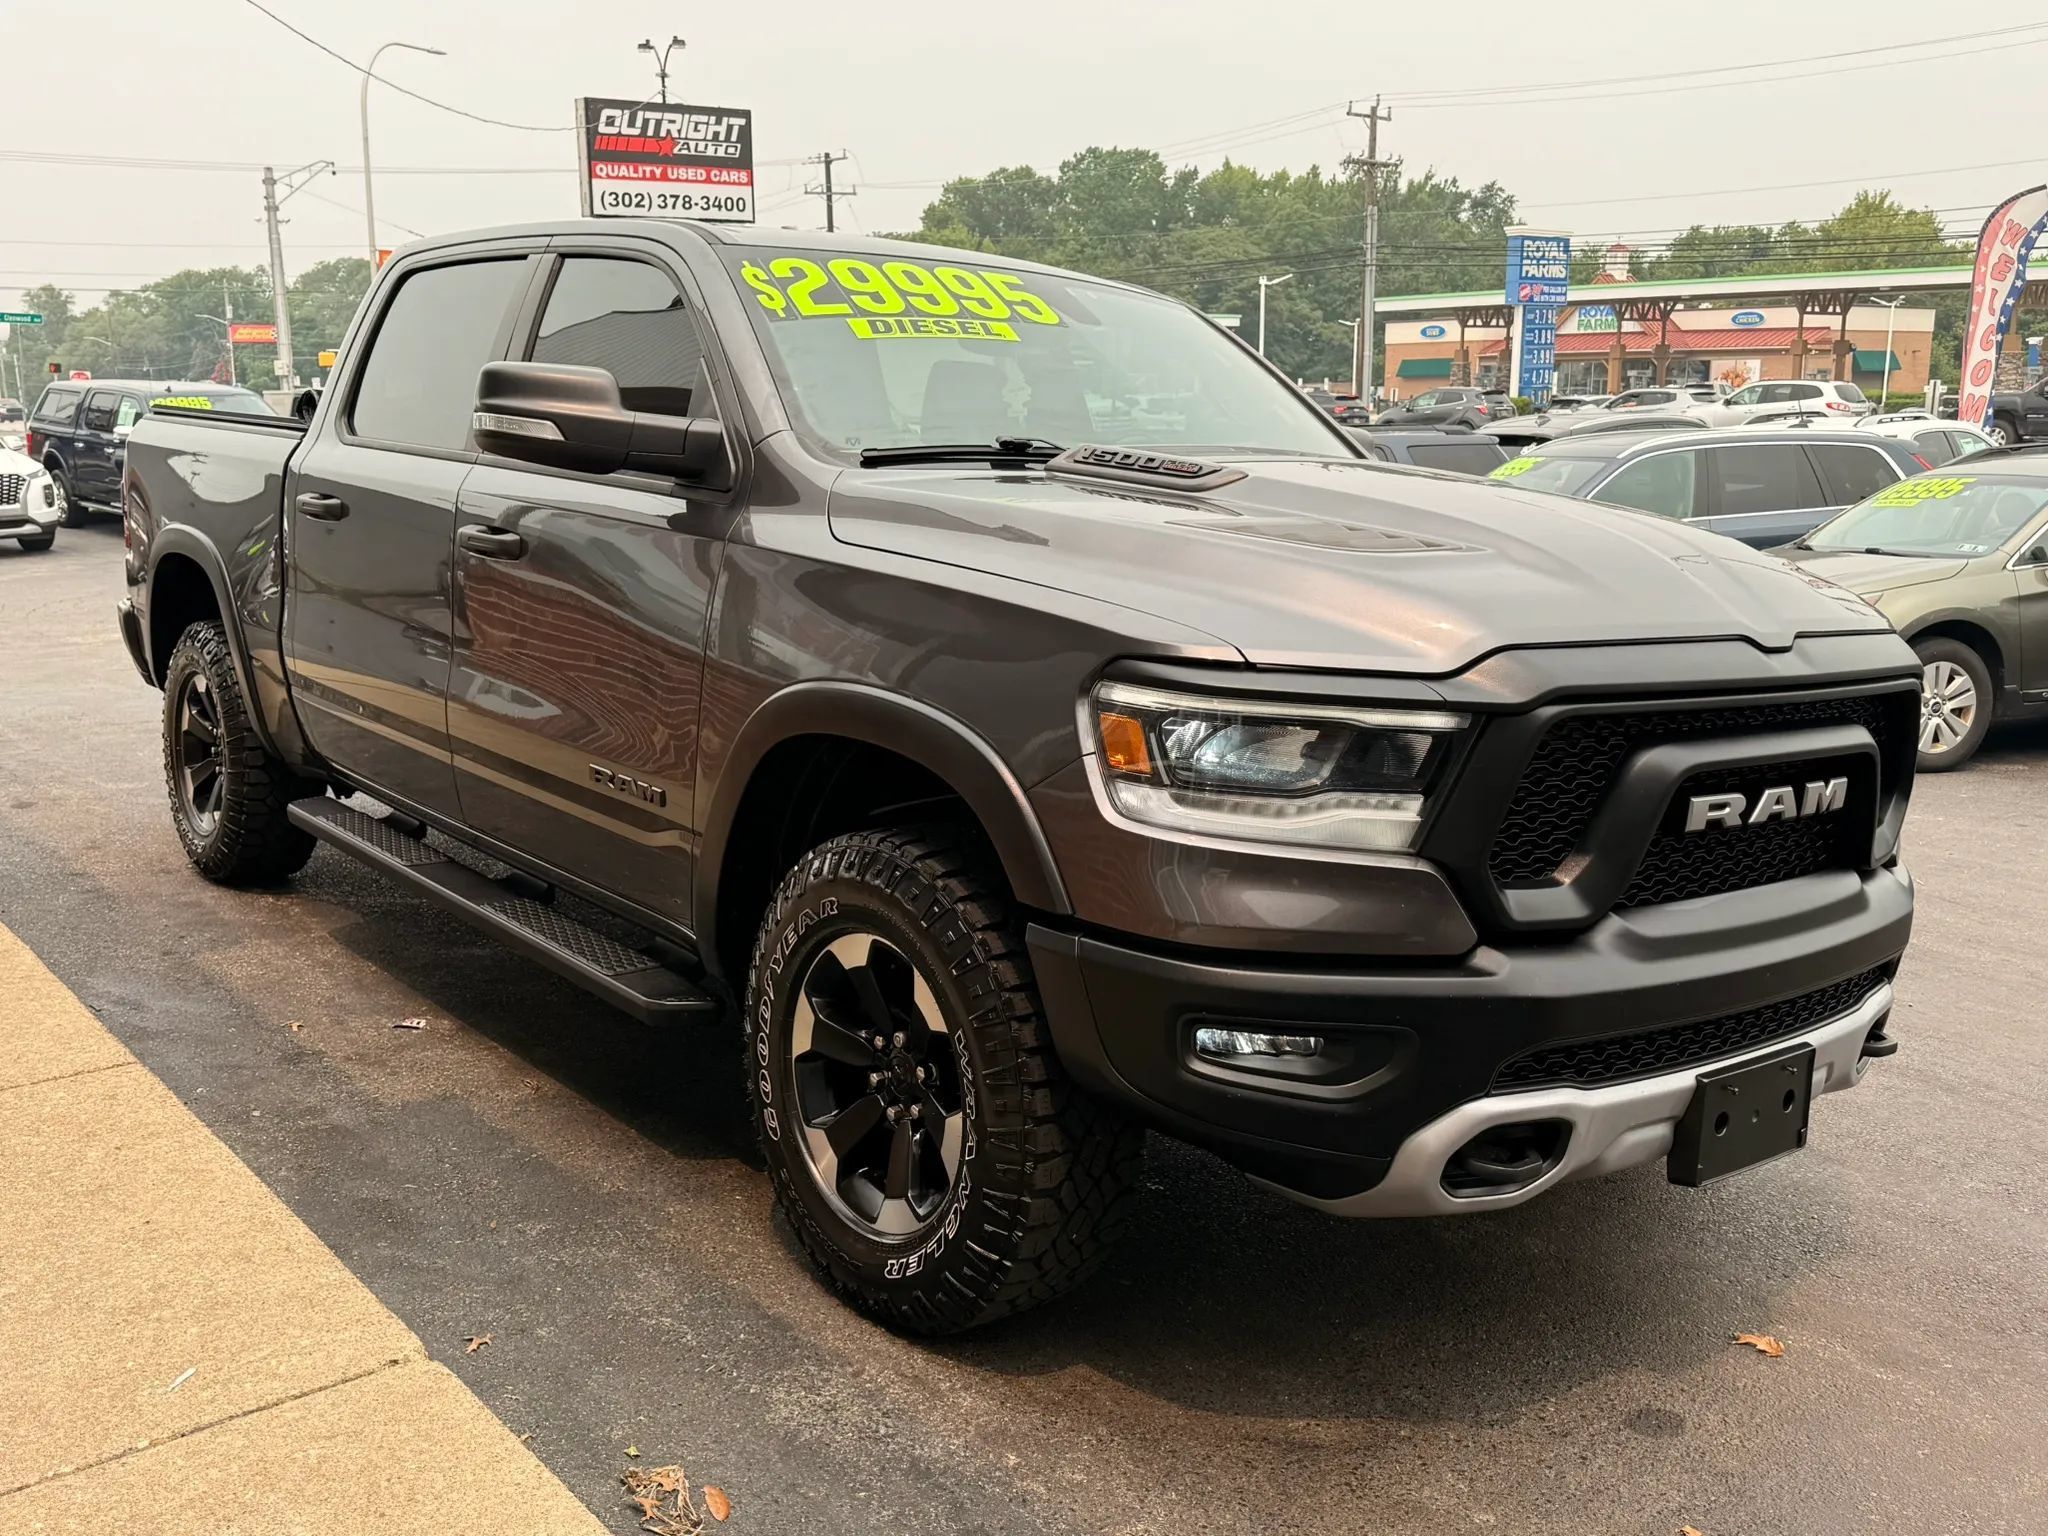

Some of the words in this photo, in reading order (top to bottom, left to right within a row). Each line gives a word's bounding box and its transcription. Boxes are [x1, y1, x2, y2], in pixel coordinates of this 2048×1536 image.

[597, 108, 747, 142] OUTRIGHT
[677, 141, 739, 156] AUTO
[595, 164, 663, 180] QUALITY
[667, 166, 707, 181] USED
[710, 169, 749, 184] CARS
[600, 190, 654, 213] (302)
[657, 193, 747, 213] 378-3400
[1522, 239, 1568, 259] ROYAL
[1521, 259, 1567, 278] FARMS
[741, 258, 1060, 325] $29995
[1578, 305, 1614, 318] ROYA
[1960, 218, 2028, 424] WELCOM
[871, 318, 1006, 339] DIESEL
[1577, 318, 1617, 331] FARM
[1080, 447, 1163, 470] 1500
[588, 763, 667, 808] RAM
[1685, 776, 1848, 832] RAM
[757, 897, 839, 1142] GOODYEAR
[884, 1028, 978, 1280] WRANGLER
